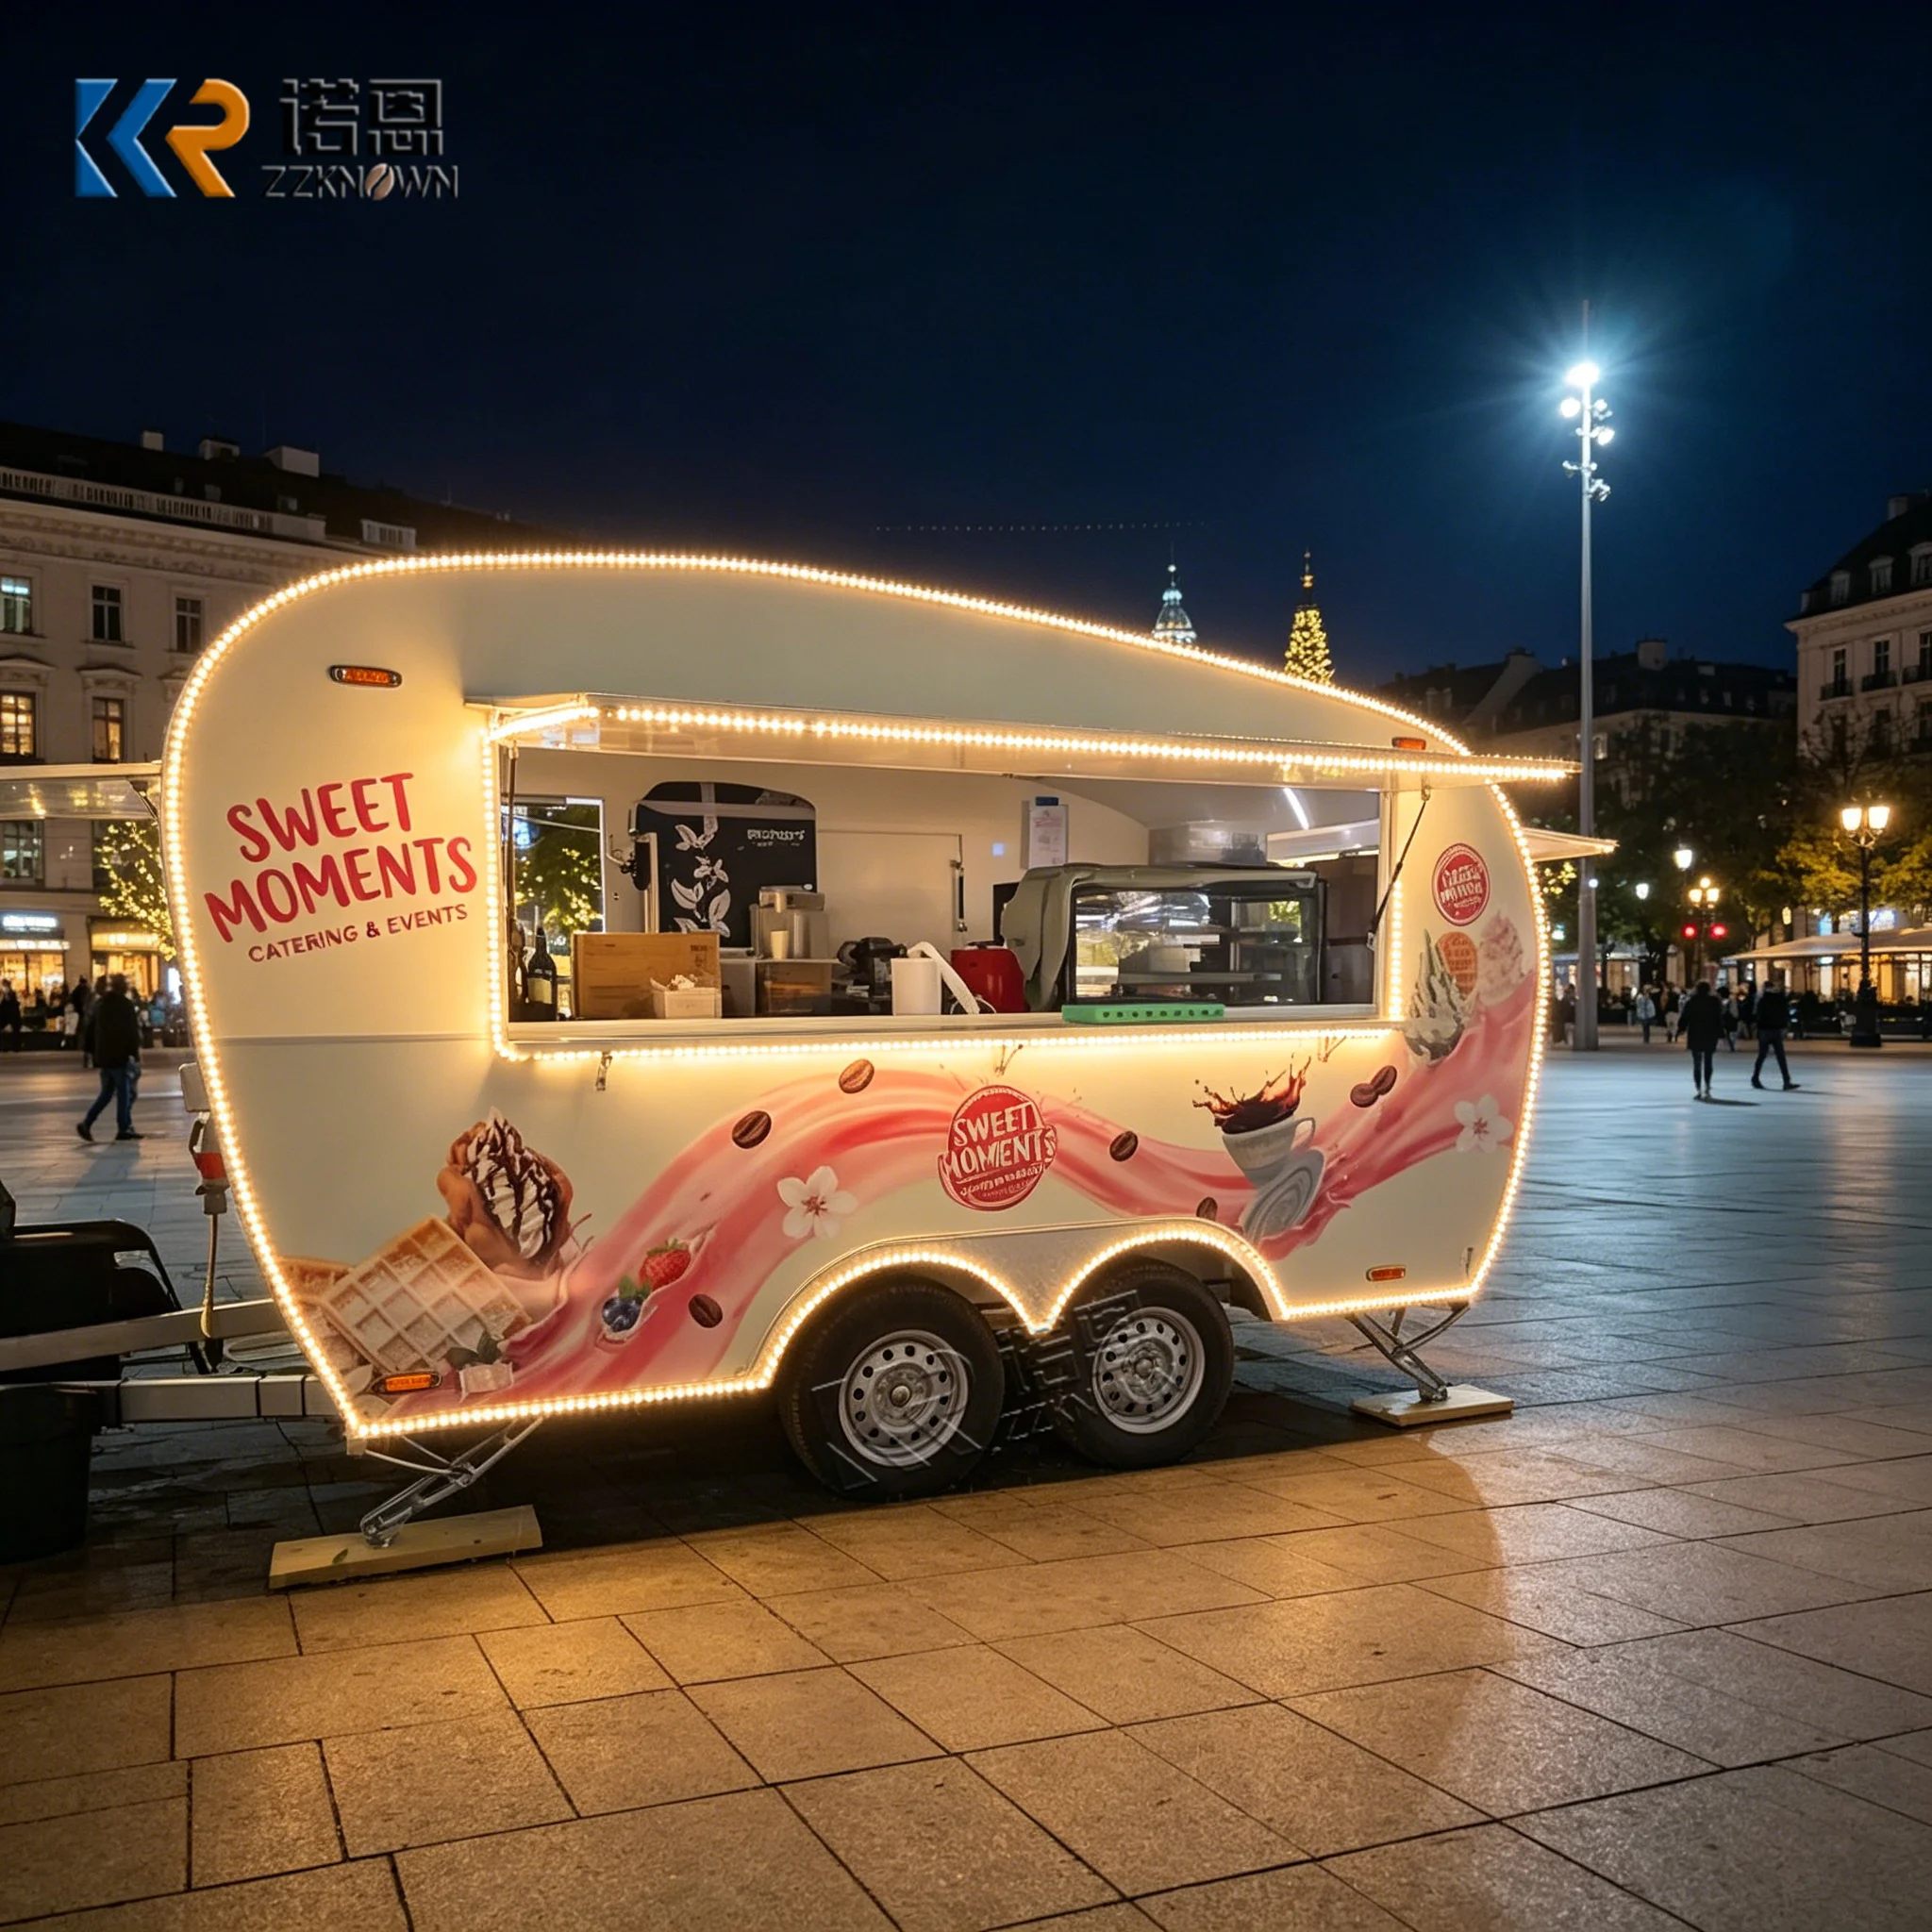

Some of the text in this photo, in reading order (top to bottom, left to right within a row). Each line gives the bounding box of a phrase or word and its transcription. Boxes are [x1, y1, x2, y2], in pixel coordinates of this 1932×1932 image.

[226, 773, 413, 863] SWEET
[204, 837, 477, 943] MOMENTS
[248, 904, 468, 962] CATERING & EVENTS
[953, 1102, 1034, 1147] SWEET
